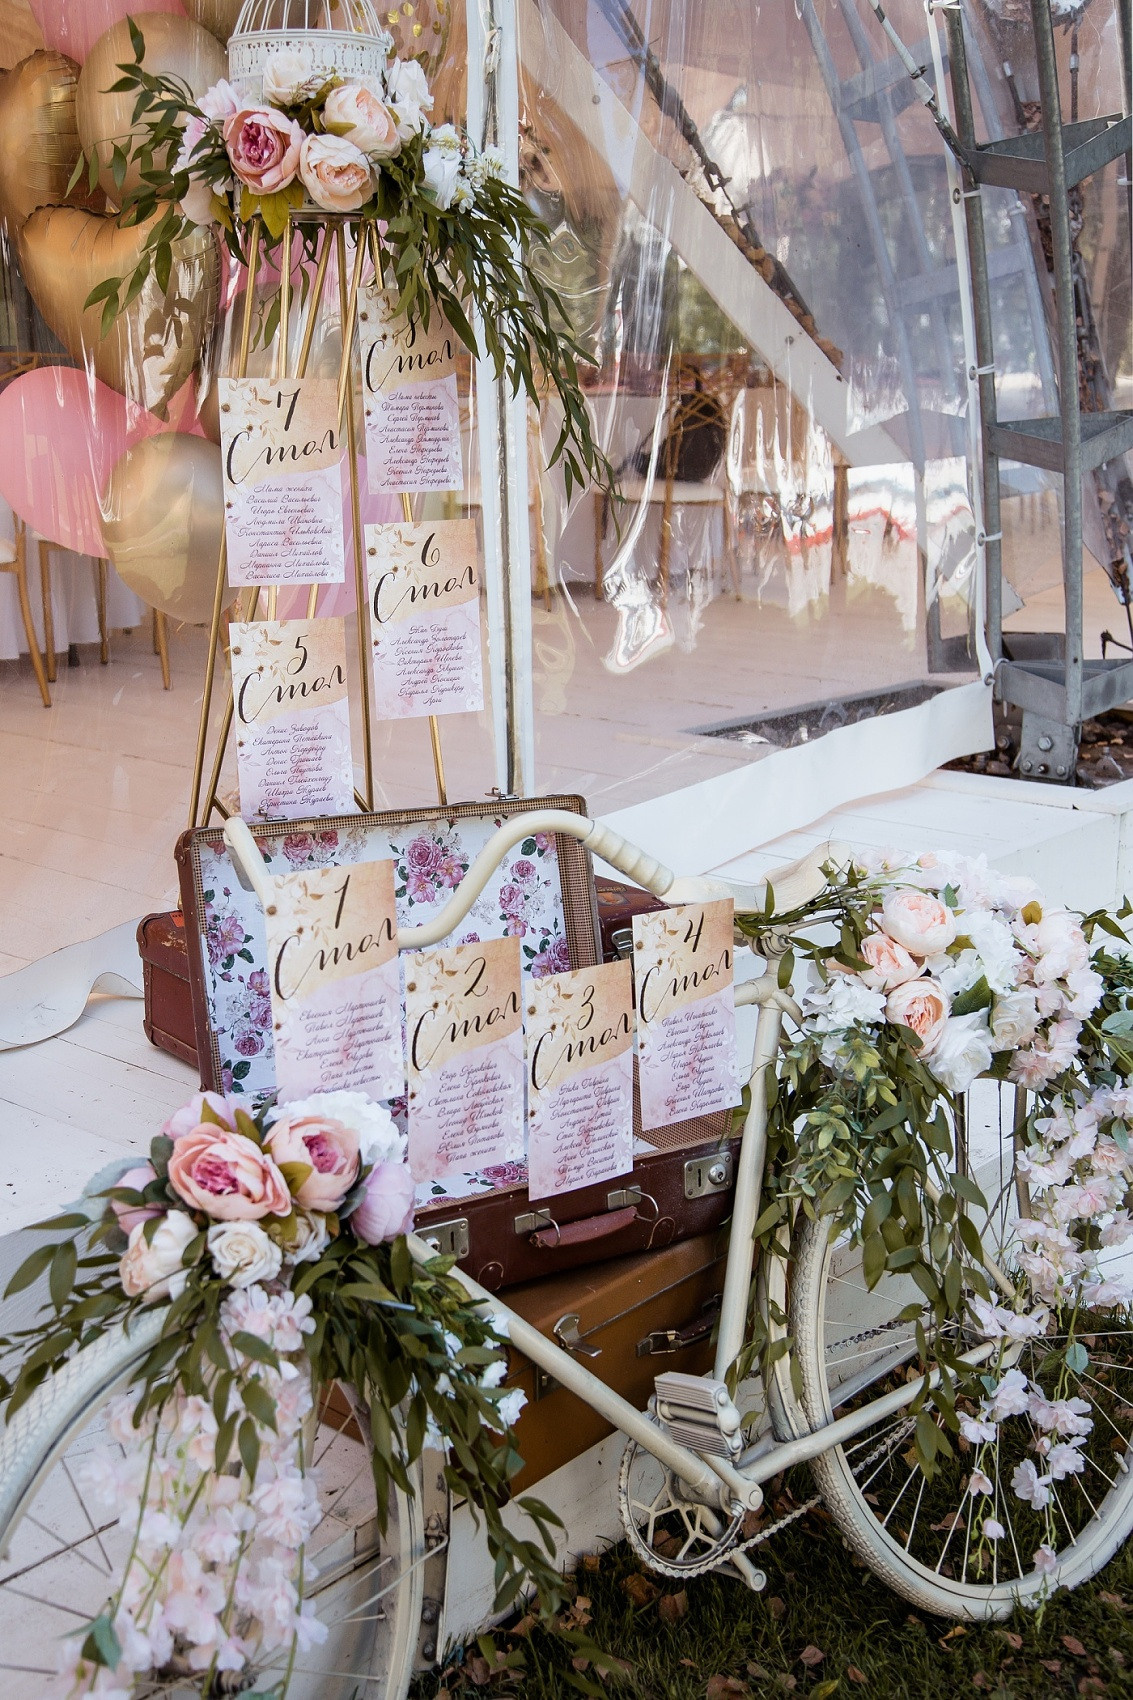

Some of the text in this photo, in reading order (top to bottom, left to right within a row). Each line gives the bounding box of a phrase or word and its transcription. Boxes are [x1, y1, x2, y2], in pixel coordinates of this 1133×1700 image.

[366, 339, 454, 392] Стол
[277, 388, 301, 431] 7
[227, 430, 338, 485] Стол
[254, 484, 283, 493] Мама
[421, 533, 440, 567] 6
[374, 566, 476, 623] Стол
[287, 635, 308, 675] 5
[238, 665, 346, 723] Стол
[334, 875, 350, 929] 1
[684, 912, 704, 952] 4
[274, 918, 396, 1000] Стол
[464, 957, 488, 996] 2
[577, 985, 594, 1030] 3
[640, 950, 732, 1023] Стол
[412, 992, 520, 1071] Стол
[531, 1013, 632, 1090] Стол
